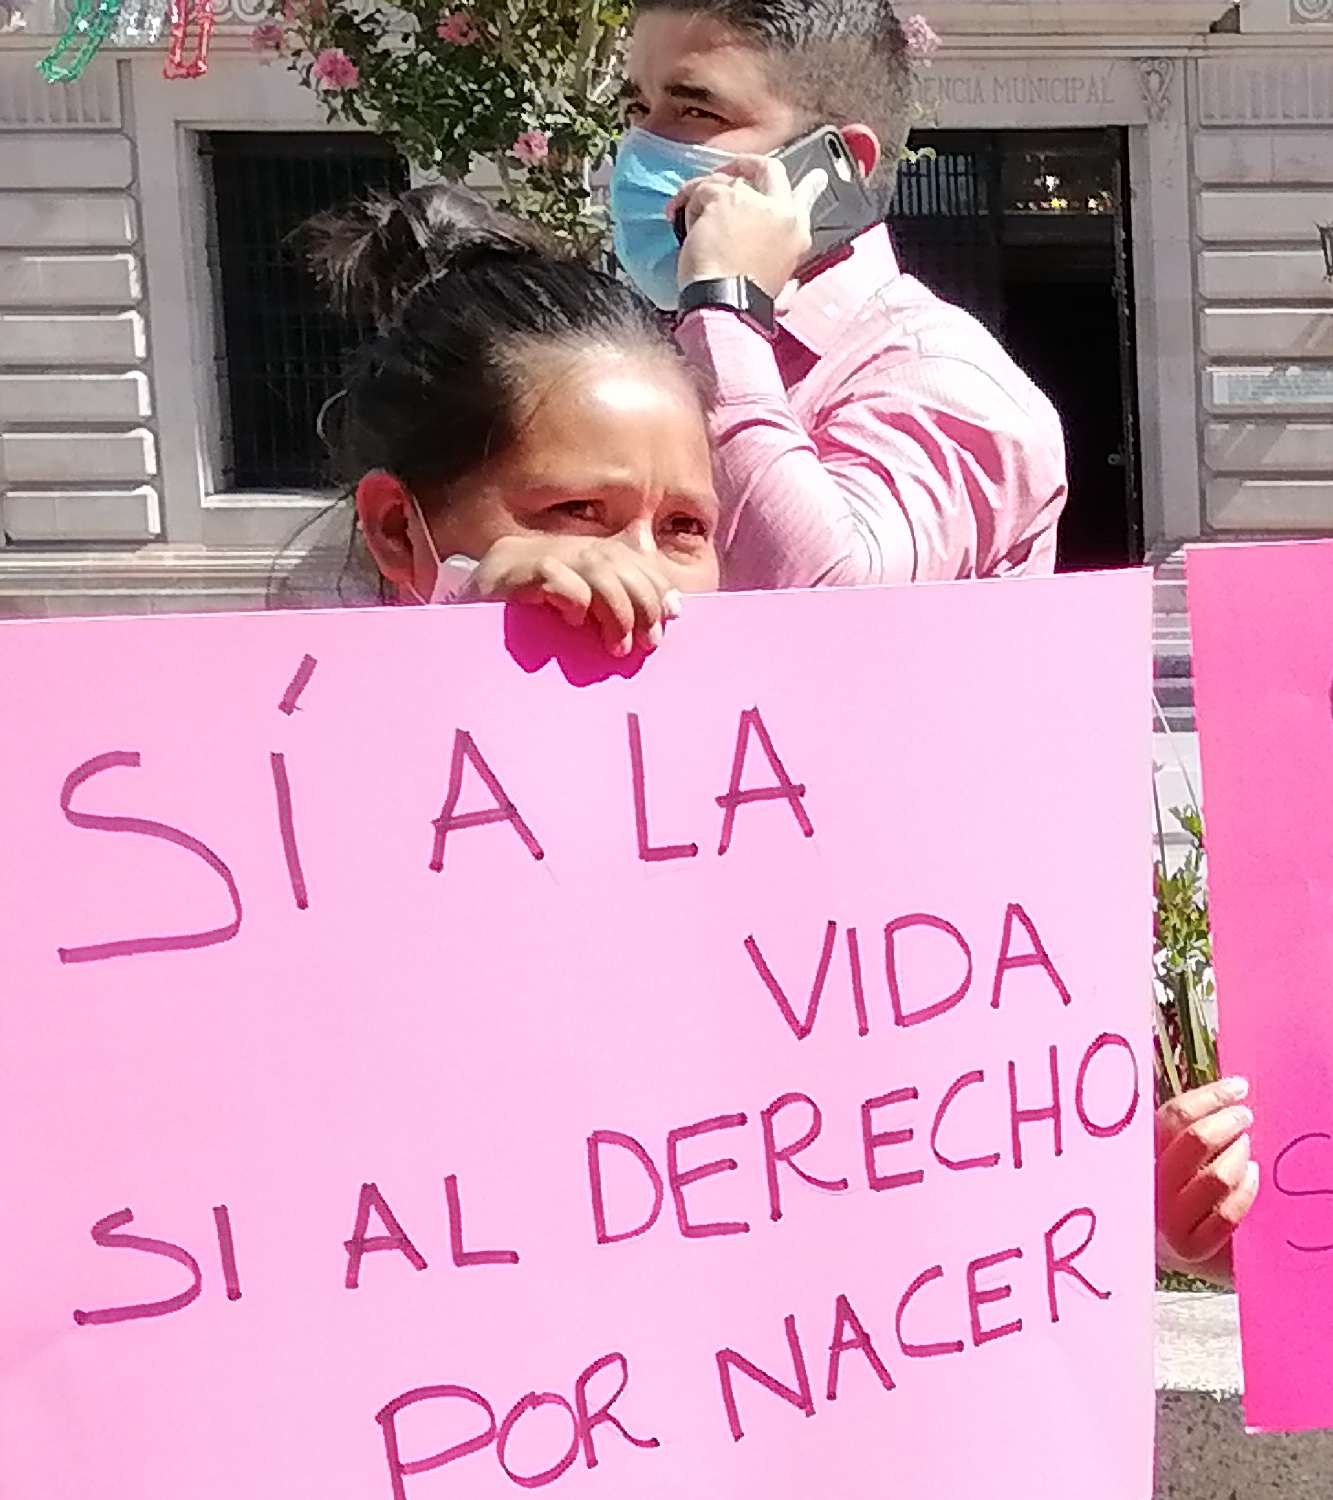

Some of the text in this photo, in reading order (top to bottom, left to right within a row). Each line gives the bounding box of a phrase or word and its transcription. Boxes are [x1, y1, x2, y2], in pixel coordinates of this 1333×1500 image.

[991, 74, 1115, 105] MUNICIPAL
[56, 653, 816, 964] SÍ A LA
[742, 901, 1072, 1041] VIDA
[72, 1031, 1140, 1327] SI AL DERECHO
[715, 1206, 1112, 1442] NACER
